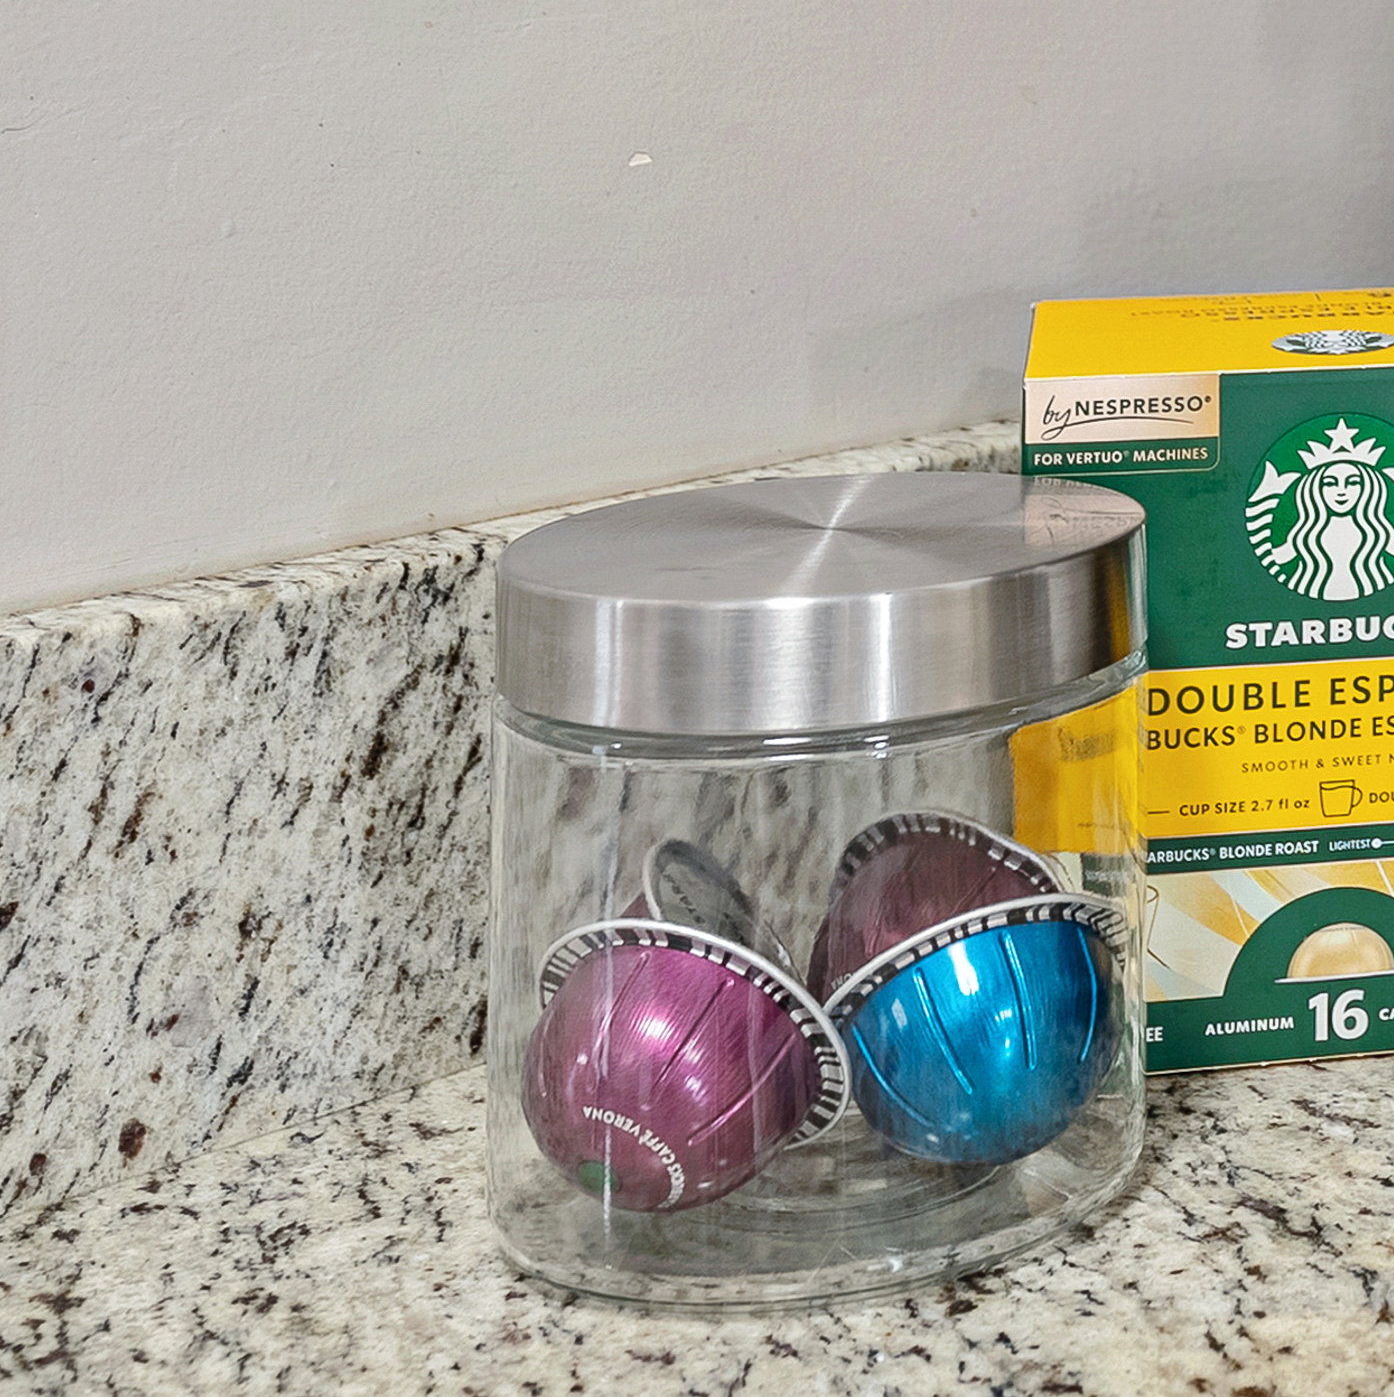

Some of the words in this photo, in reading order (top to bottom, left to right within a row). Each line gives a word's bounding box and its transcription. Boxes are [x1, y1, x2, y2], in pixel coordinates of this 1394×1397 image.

[1041, 395, 1071, 440] by
[1075, 396, 1204, 416] NESPRESSO
[1034, 453, 1062, 466] FOR
[1067, 450, 1123, 464] VERTUO
[1133, 447, 1208, 462] MACHINES
[1148, 679, 1312, 716] DOUBLE
[1146, 725, 1236, 751] BUCKS
[1254, 718, 1363, 745] BLONDE
[1241, 757, 1310, 775] SMOOTH
[1316, 757, 1325, 769] &
[1332, 753, 1382, 769] SWEET
[1179, 802, 1210, 816] CUP
[1214, 801, 1247, 815] SIZE
[1250, 799, 1274, 813] 2.7
[1294, 799, 1310, 810] oz
[1147, 846, 1211, 864] ARBUCKS
[1218, 843, 1274, 860] BLONDE
[1274, 838, 1320, 856] ROAST
[1328, 837, 1372, 852] LIGHTEST
[1204, 1016, 1295, 1037] ALUMINUM
[1309, 989, 1370, 1042] 16
[582, 1105, 642, 1137] VERONA
